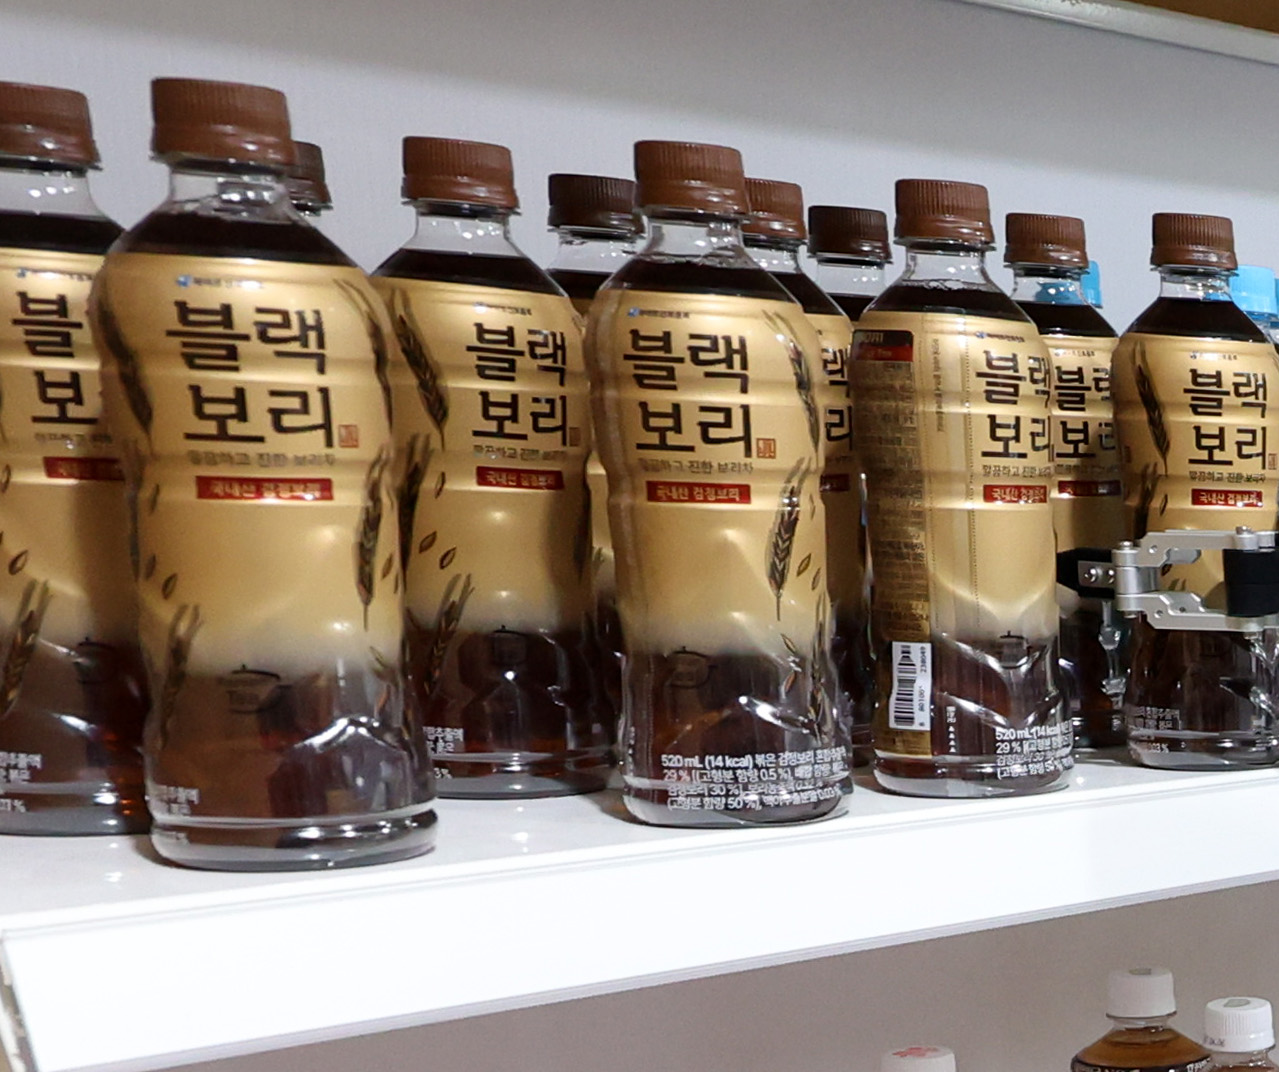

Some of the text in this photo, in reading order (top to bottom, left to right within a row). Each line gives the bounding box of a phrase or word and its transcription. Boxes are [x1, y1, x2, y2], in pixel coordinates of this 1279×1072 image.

[11, 291, 83, 359] 블
[166, 299, 328, 376] 블랙
[466, 322, 567, 387] 블랙
[623, 328, 750, 395] 블랙
[975, 350, 1052, 409] 블랙
[32, 371, 98, 425] 보
[184, 385, 335, 449] 보리
[472, 391, 568, 446] 보리
[1183, 369, 1268, 418] 블랙
[636, 400, 754, 458] 보리
[981, 414, 1055, 462] 보리
[1188, 426, 1267, 470] 보리
[656, 485, 690, 502] 국내산
[688, 460, 714, 476] 진한
[996, 730, 1016, 741] 520
[996, 742, 1013, 755] 29
[661, 755, 684, 769] 520
[684, 756, 702, 769] mL
[705, 754, 725, 770] (14
[725, 754, 753, 770] kcal)
[727, 796, 744, 809] 50
